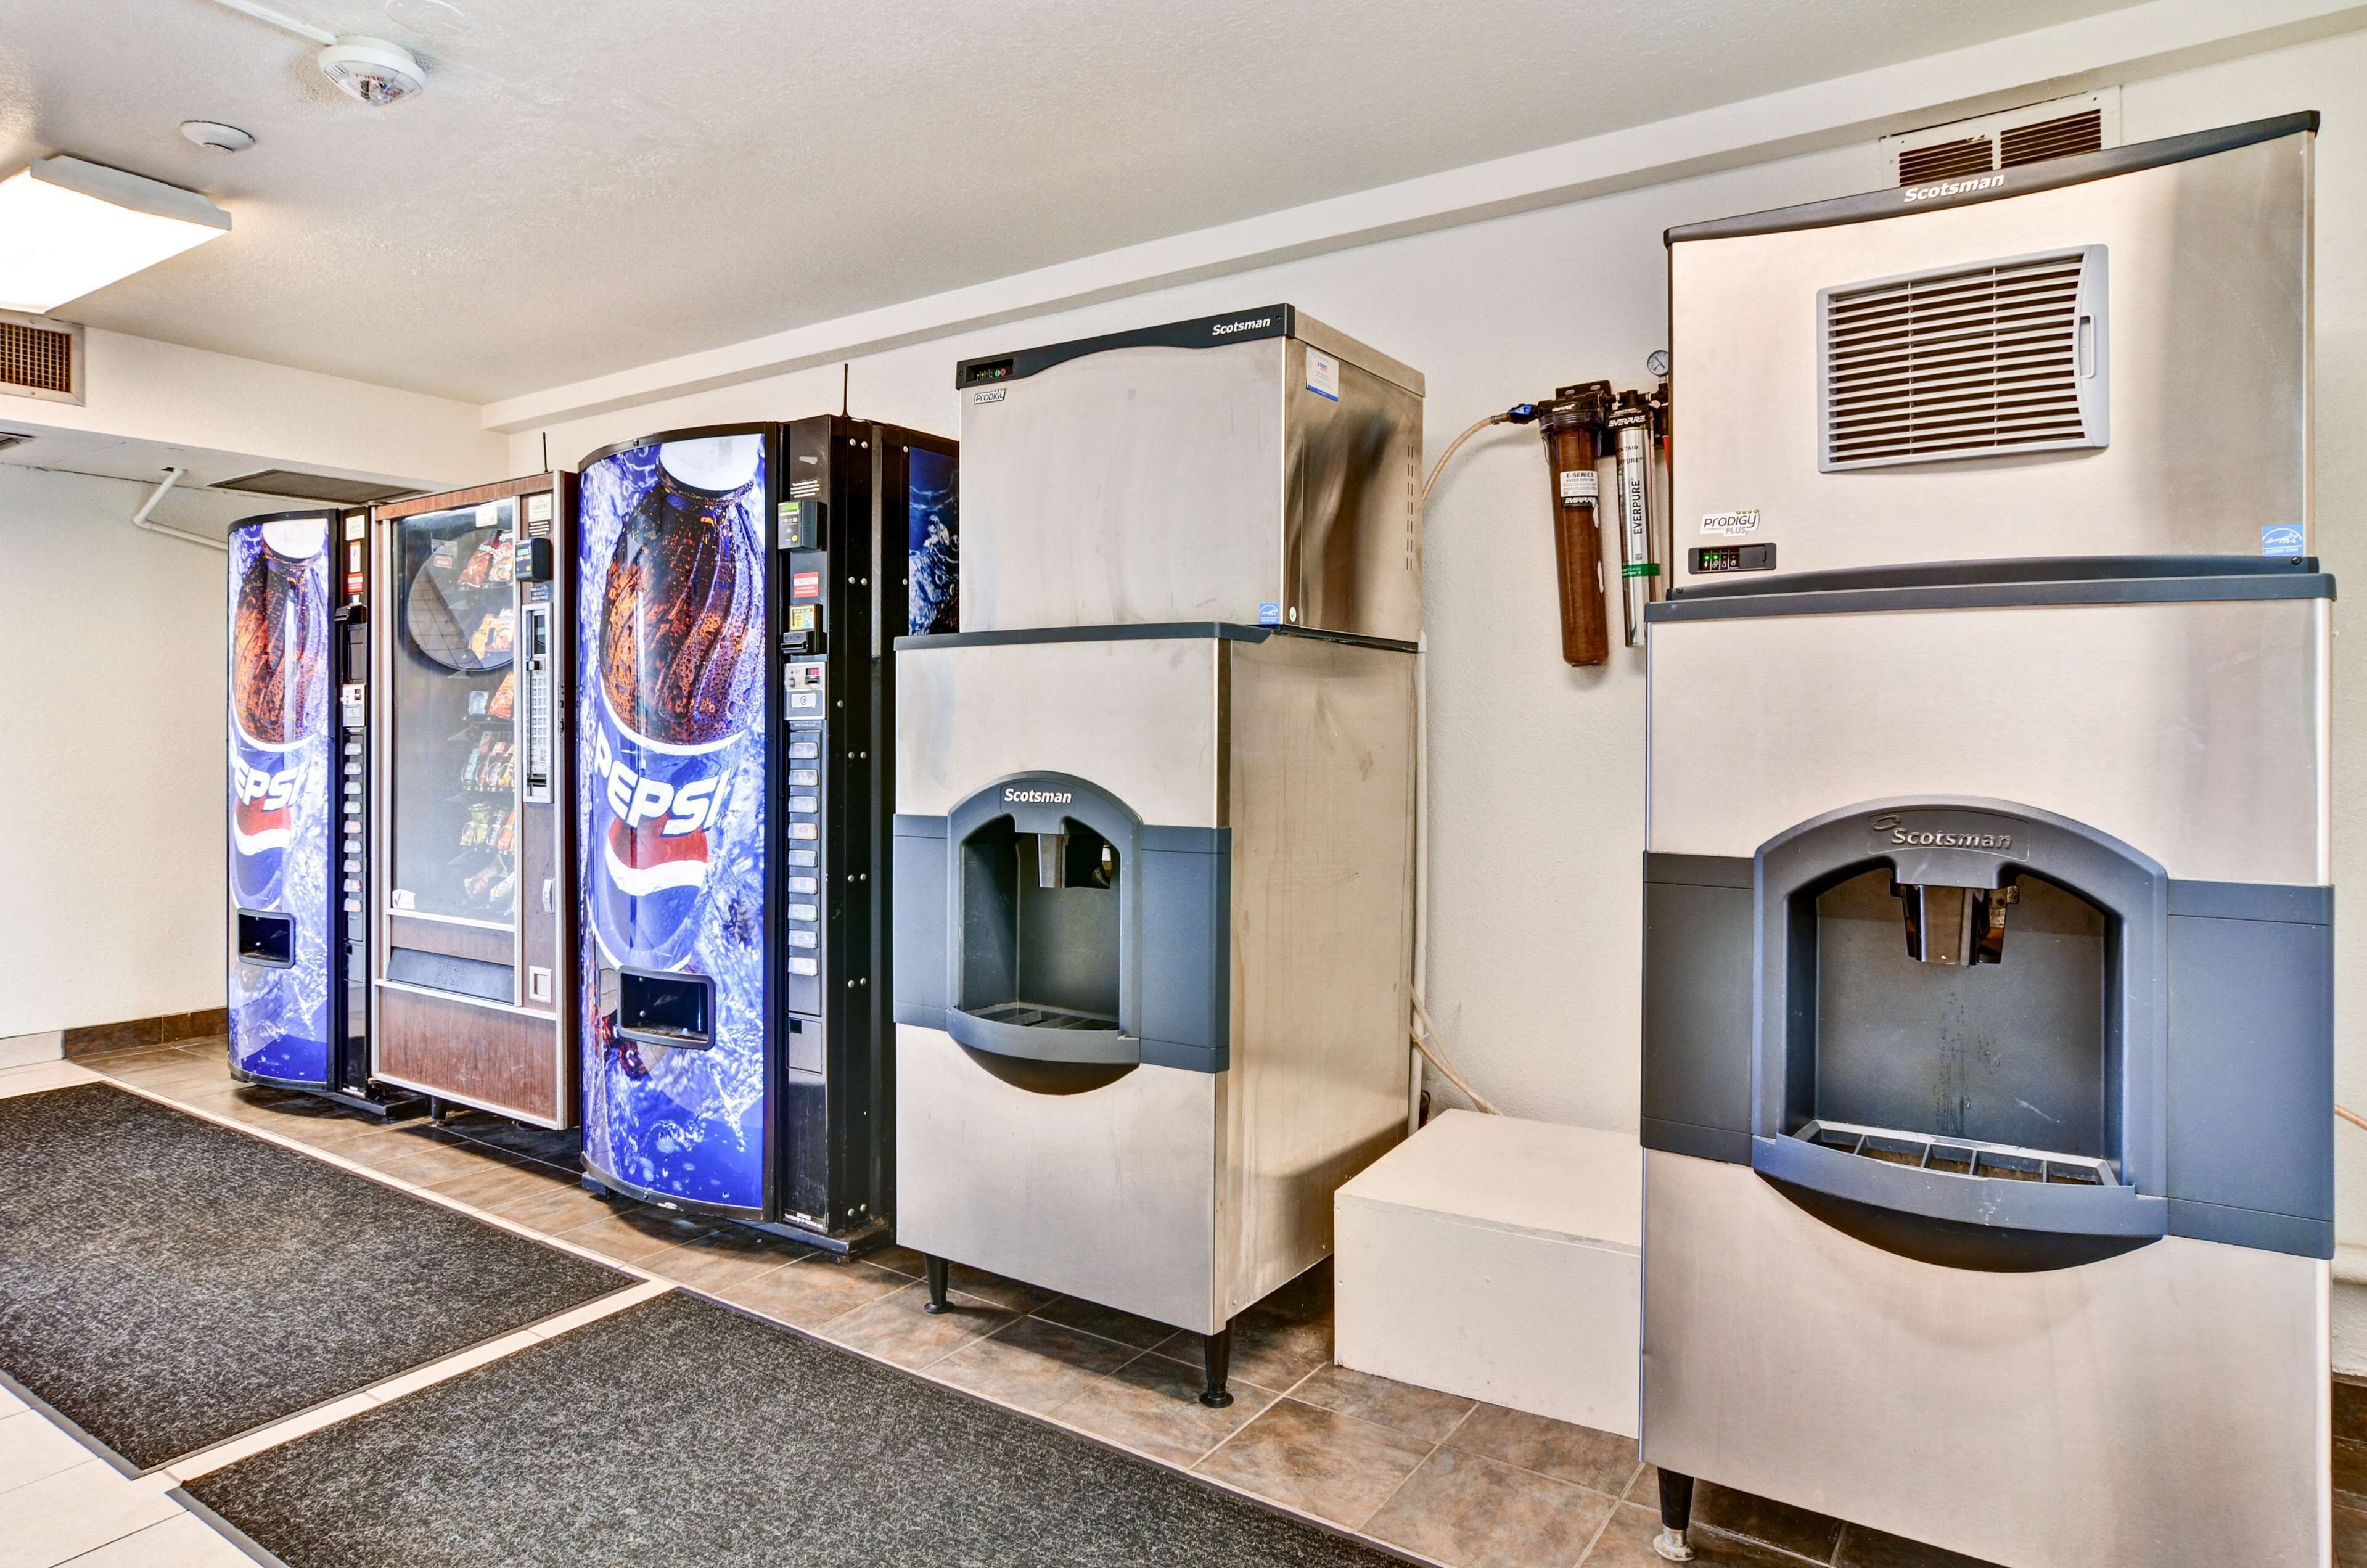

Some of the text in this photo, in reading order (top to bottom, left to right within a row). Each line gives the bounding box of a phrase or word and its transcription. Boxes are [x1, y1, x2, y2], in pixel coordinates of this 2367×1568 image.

[1904, 174, 2004, 202] Scotsman
[1212, 318, 1271, 335] Scotsman
[1609, 415, 1646, 427] EVERPURE
[1631, 480, 1642, 534] EVERPURE
[594, 721, 730, 835] PEPSI
[1004, 788, 1072, 803] Scotsman
[1891, 827, 2012, 849] Scotsman
